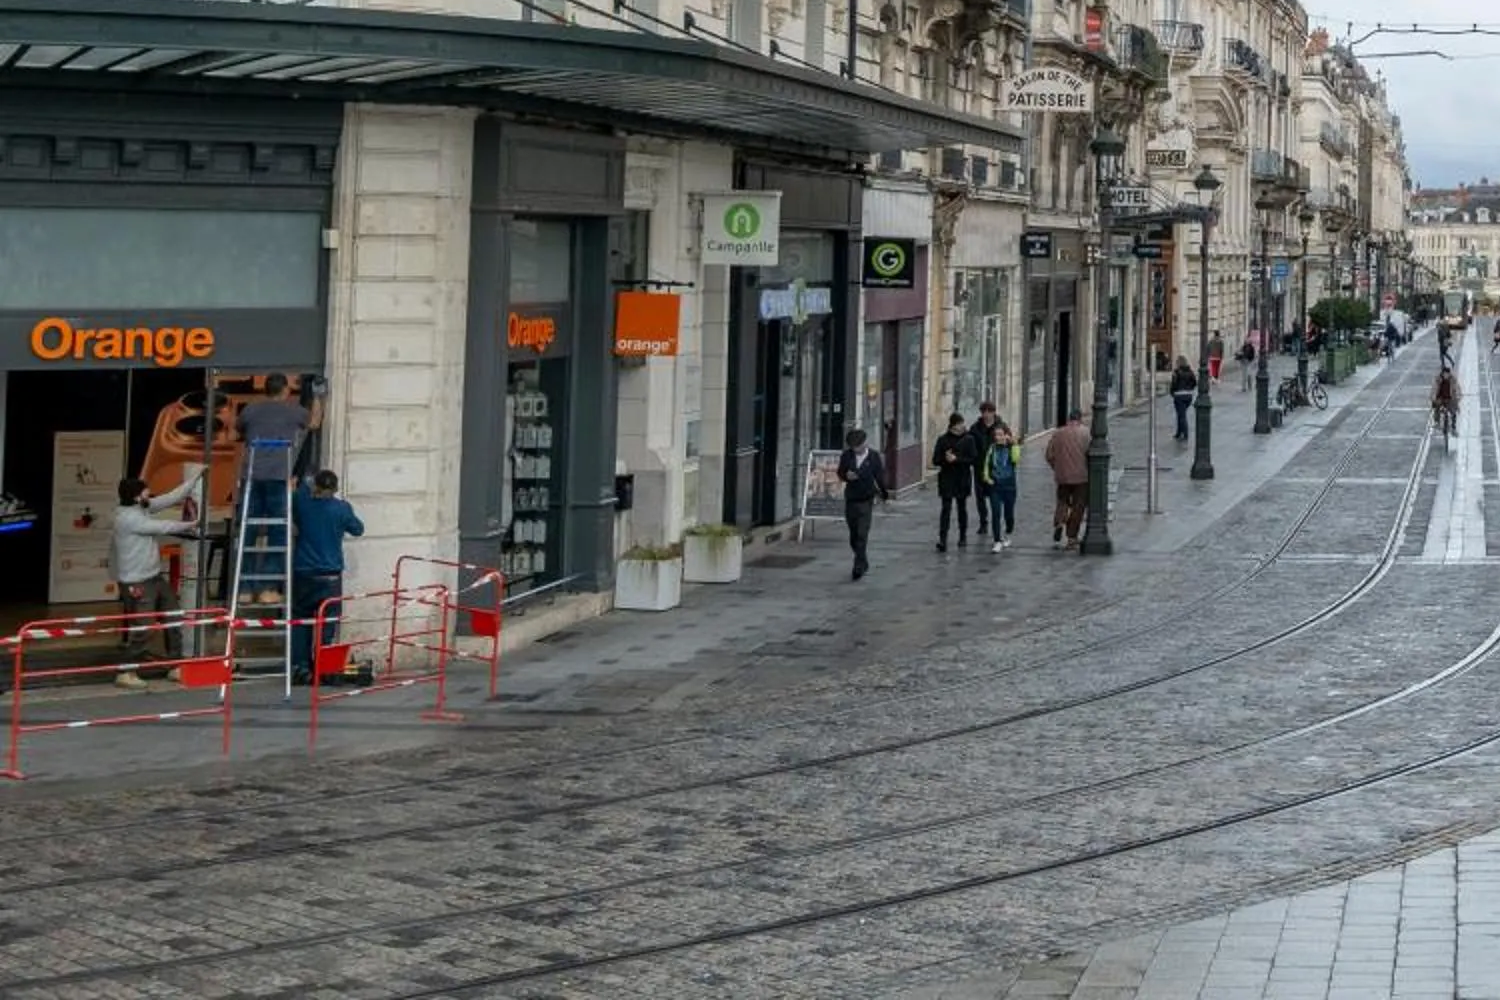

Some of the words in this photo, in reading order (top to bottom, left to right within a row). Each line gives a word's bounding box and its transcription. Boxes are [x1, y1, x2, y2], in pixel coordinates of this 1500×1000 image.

[1008, 93, 1086, 107] PATISSERIE
[707, 240, 774, 256] Campanile
[507, 312, 557, 352] Orange
[31, 317, 215, 367] Orange
[617, 339, 671, 355] orange
